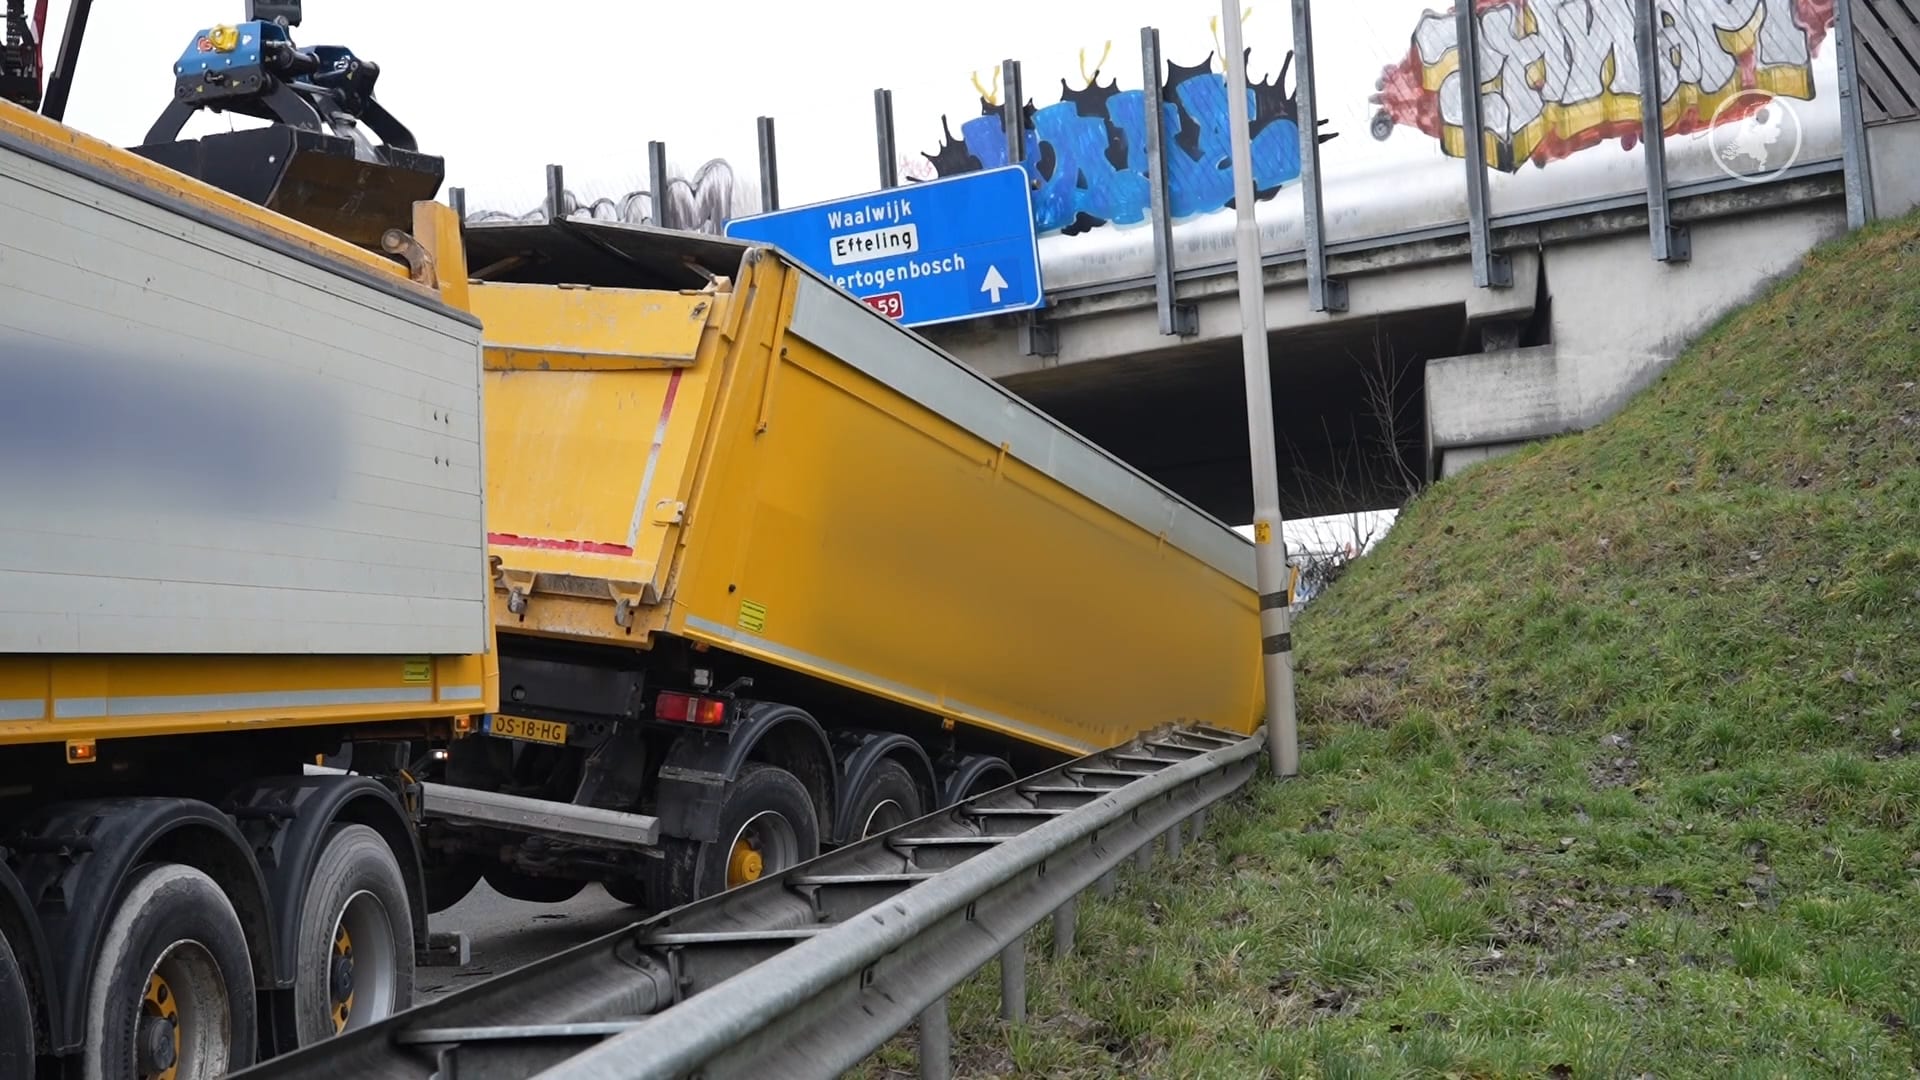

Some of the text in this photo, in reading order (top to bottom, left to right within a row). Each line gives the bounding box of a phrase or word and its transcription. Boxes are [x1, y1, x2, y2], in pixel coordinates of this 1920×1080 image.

[828, 198, 912, 230] Waalwijk
[836, 231, 912, 257] Efteling
[867, 297, 899, 314] 59
[496, 717, 562, 741] OS-18-HG
